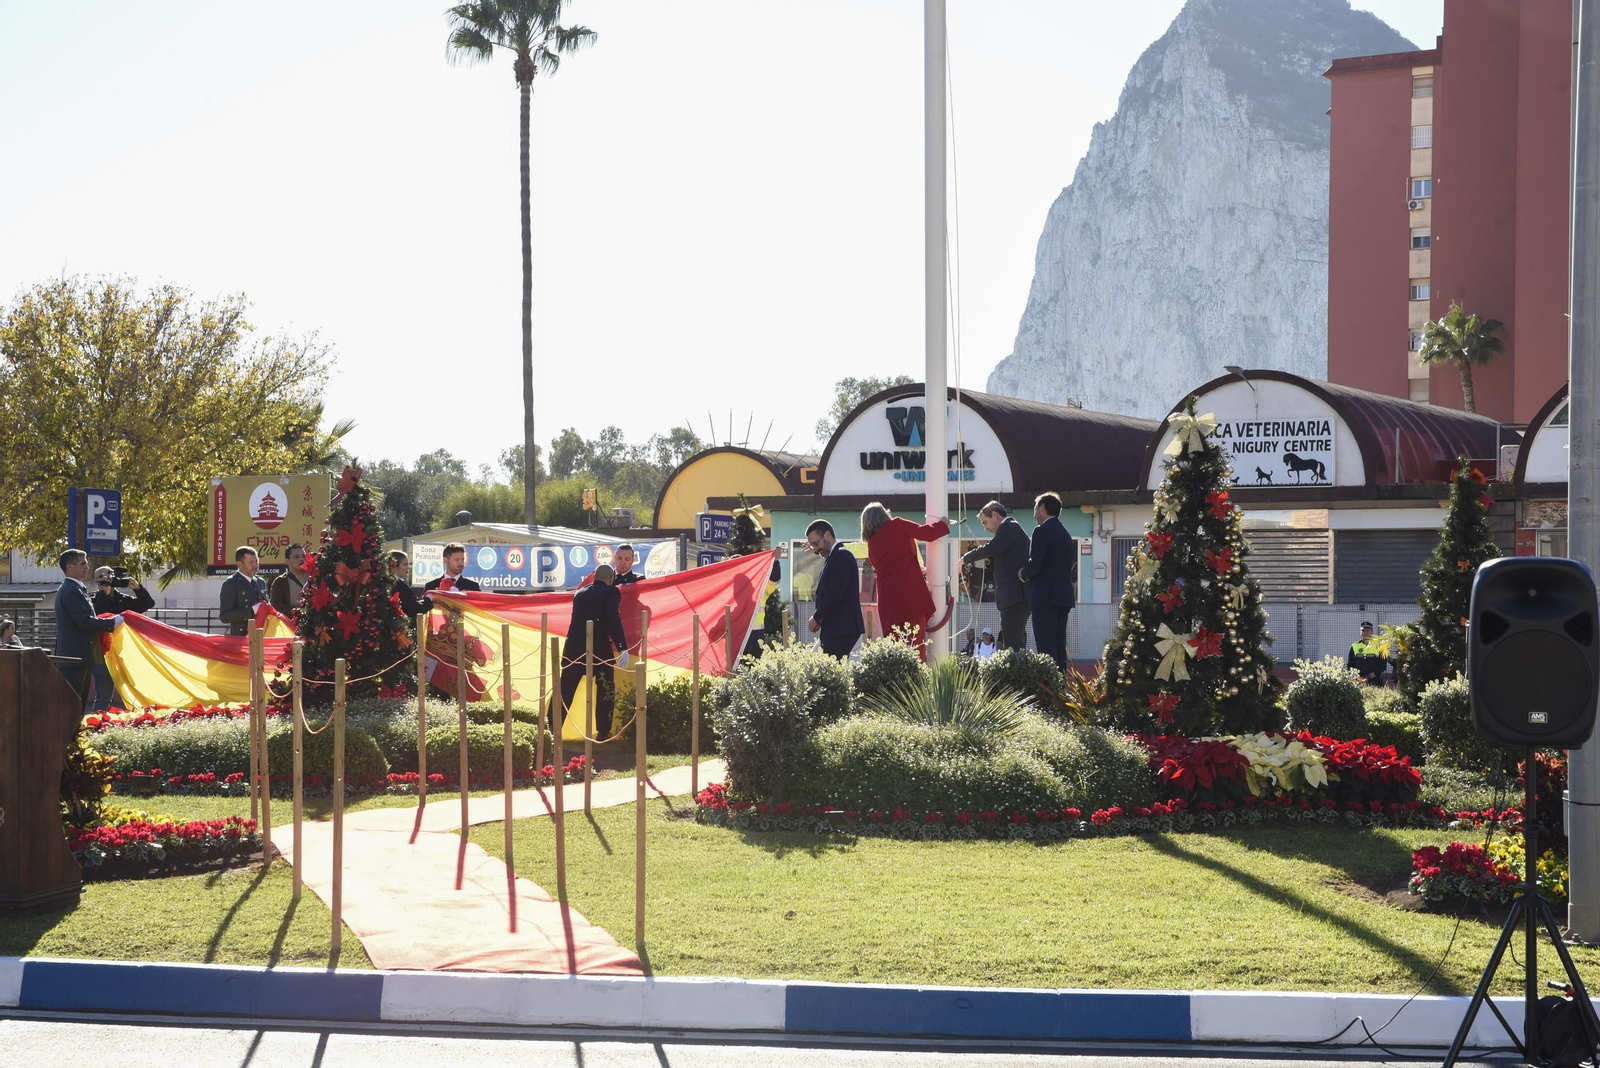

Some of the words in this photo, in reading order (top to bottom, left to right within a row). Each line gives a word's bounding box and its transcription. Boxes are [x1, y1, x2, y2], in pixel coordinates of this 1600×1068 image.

[1236, 420, 1332, 438] VETERINARIA
[1232, 440, 1279, 454] NIGURY
[1283, 439, 1332, 452] CENTRE
[860, 441, 975, 470] uniwrk
[901, 469, 976, 482] UNIMES
[87, 494, 105, 525] P
[703, 520, 710, 537] P
[714, 529, 722, 538] 24
[258, 543, 280, 559] City
[415, 552, 441, 560] Peatonal
[509, 553, 521, 563] 20
[536, 550, 559, 584] P
